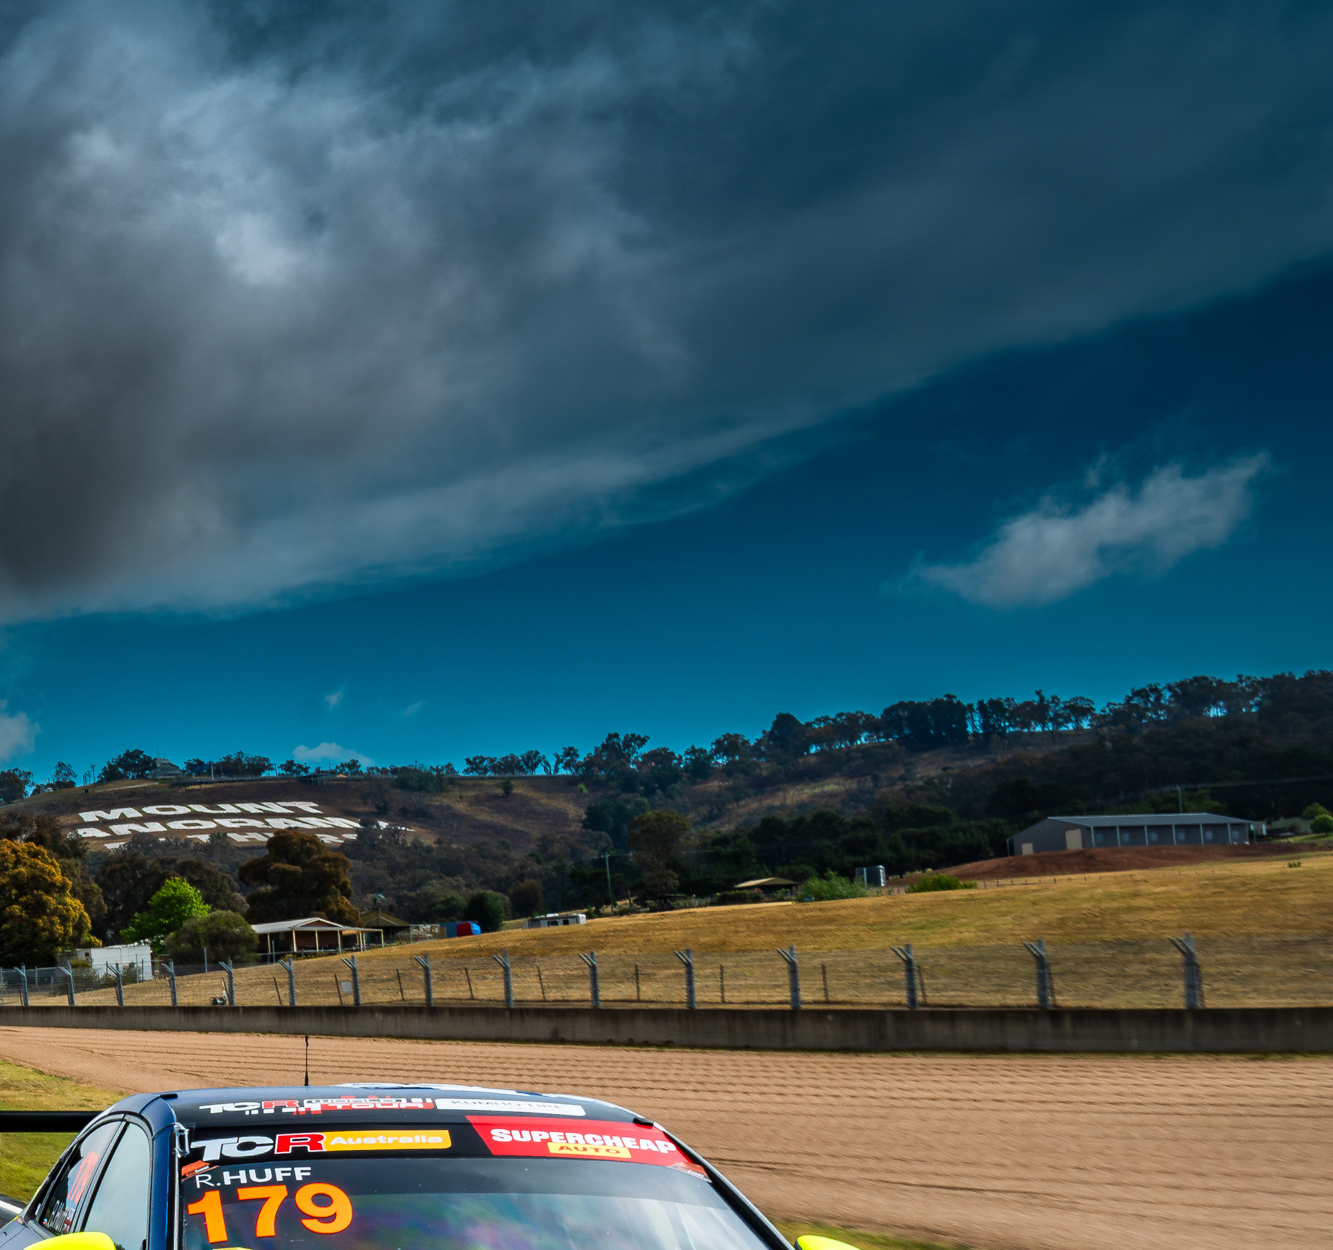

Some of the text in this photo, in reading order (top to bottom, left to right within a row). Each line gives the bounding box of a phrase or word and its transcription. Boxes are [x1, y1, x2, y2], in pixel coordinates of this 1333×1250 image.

[78, 801, 323, 822] MOUNT
[199, 1100, 298, 1114] TCR
[190, 1132, 443, 1161] TCR Australia
[490, 1128, 677, 1154] SUPERCHEAP
[557, 1145, 621, 1155] AUTO
[188, 1183, 353, 1243] 179
